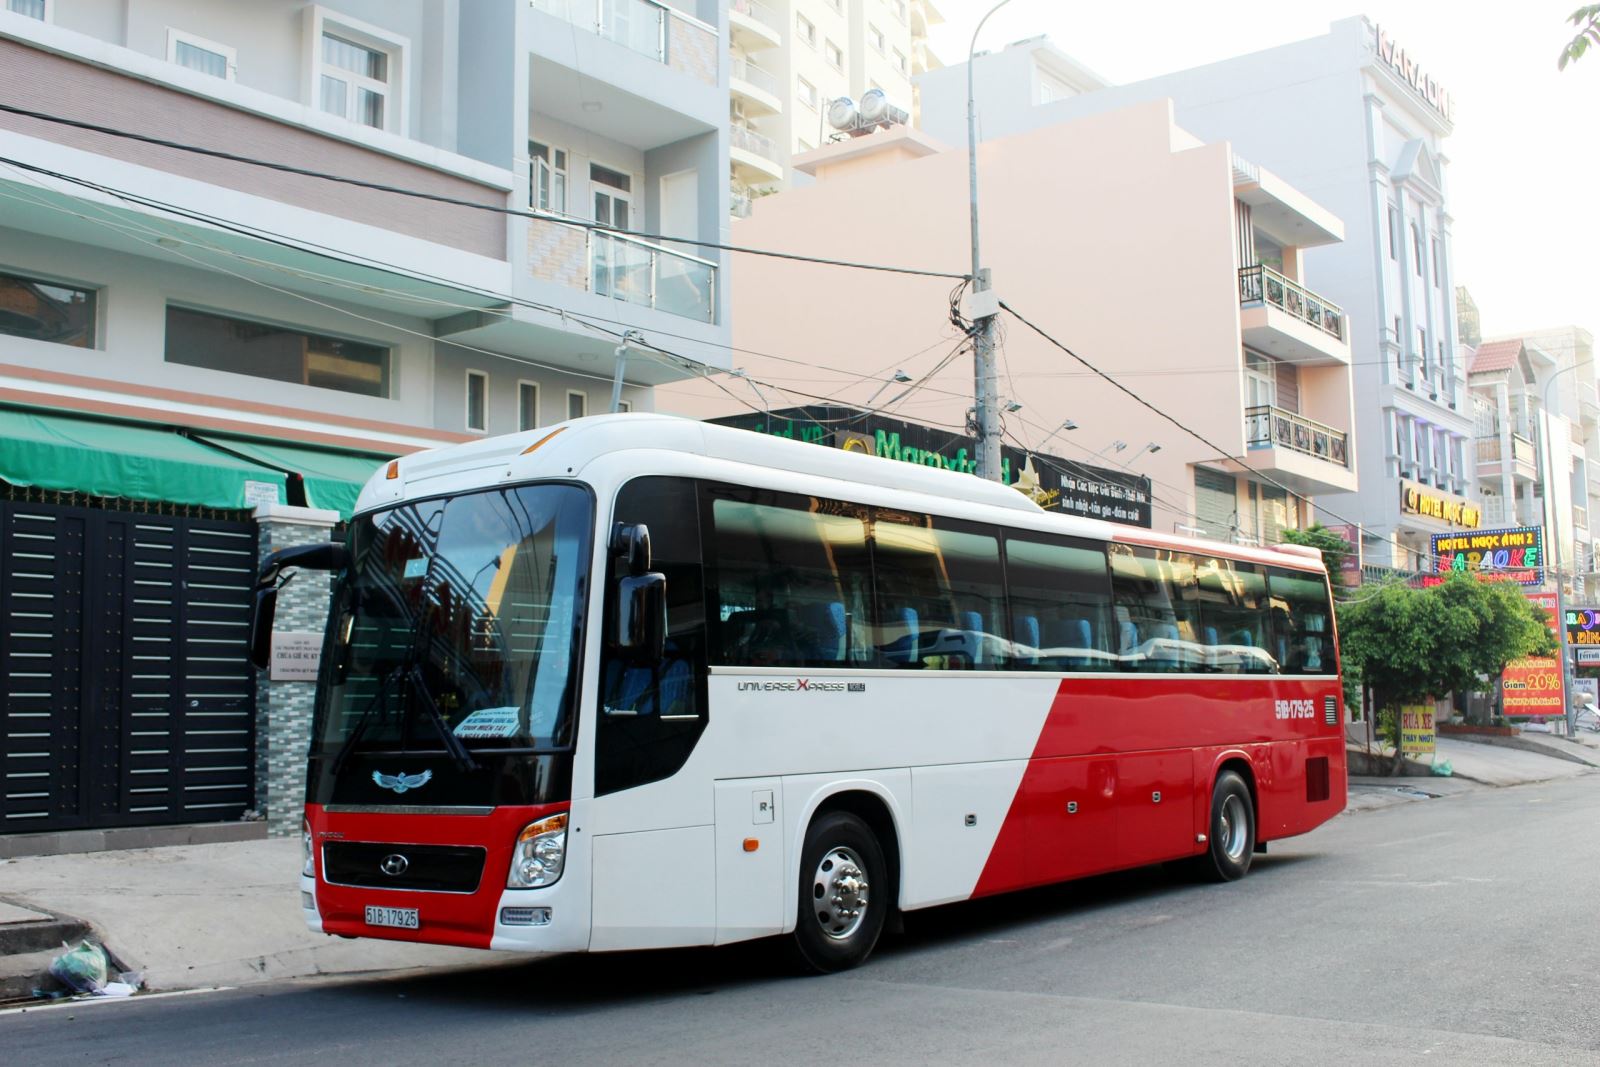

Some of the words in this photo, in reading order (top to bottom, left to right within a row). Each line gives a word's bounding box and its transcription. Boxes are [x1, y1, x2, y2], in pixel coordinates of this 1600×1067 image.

[1420, 493, 1442, 518] HOTEL
[1438, 538, 1469, 551] HOTEL
[1526, 533, 1533, 544] 2
[1438, 547, 1537, 572] KARAOKE
[1577, 630, 1600, 644] ĐÌN
[1528, 673, 1560, 690] 20%
[1422, 712, 1432, 729] XE
[760, 802, 767, 811] R
